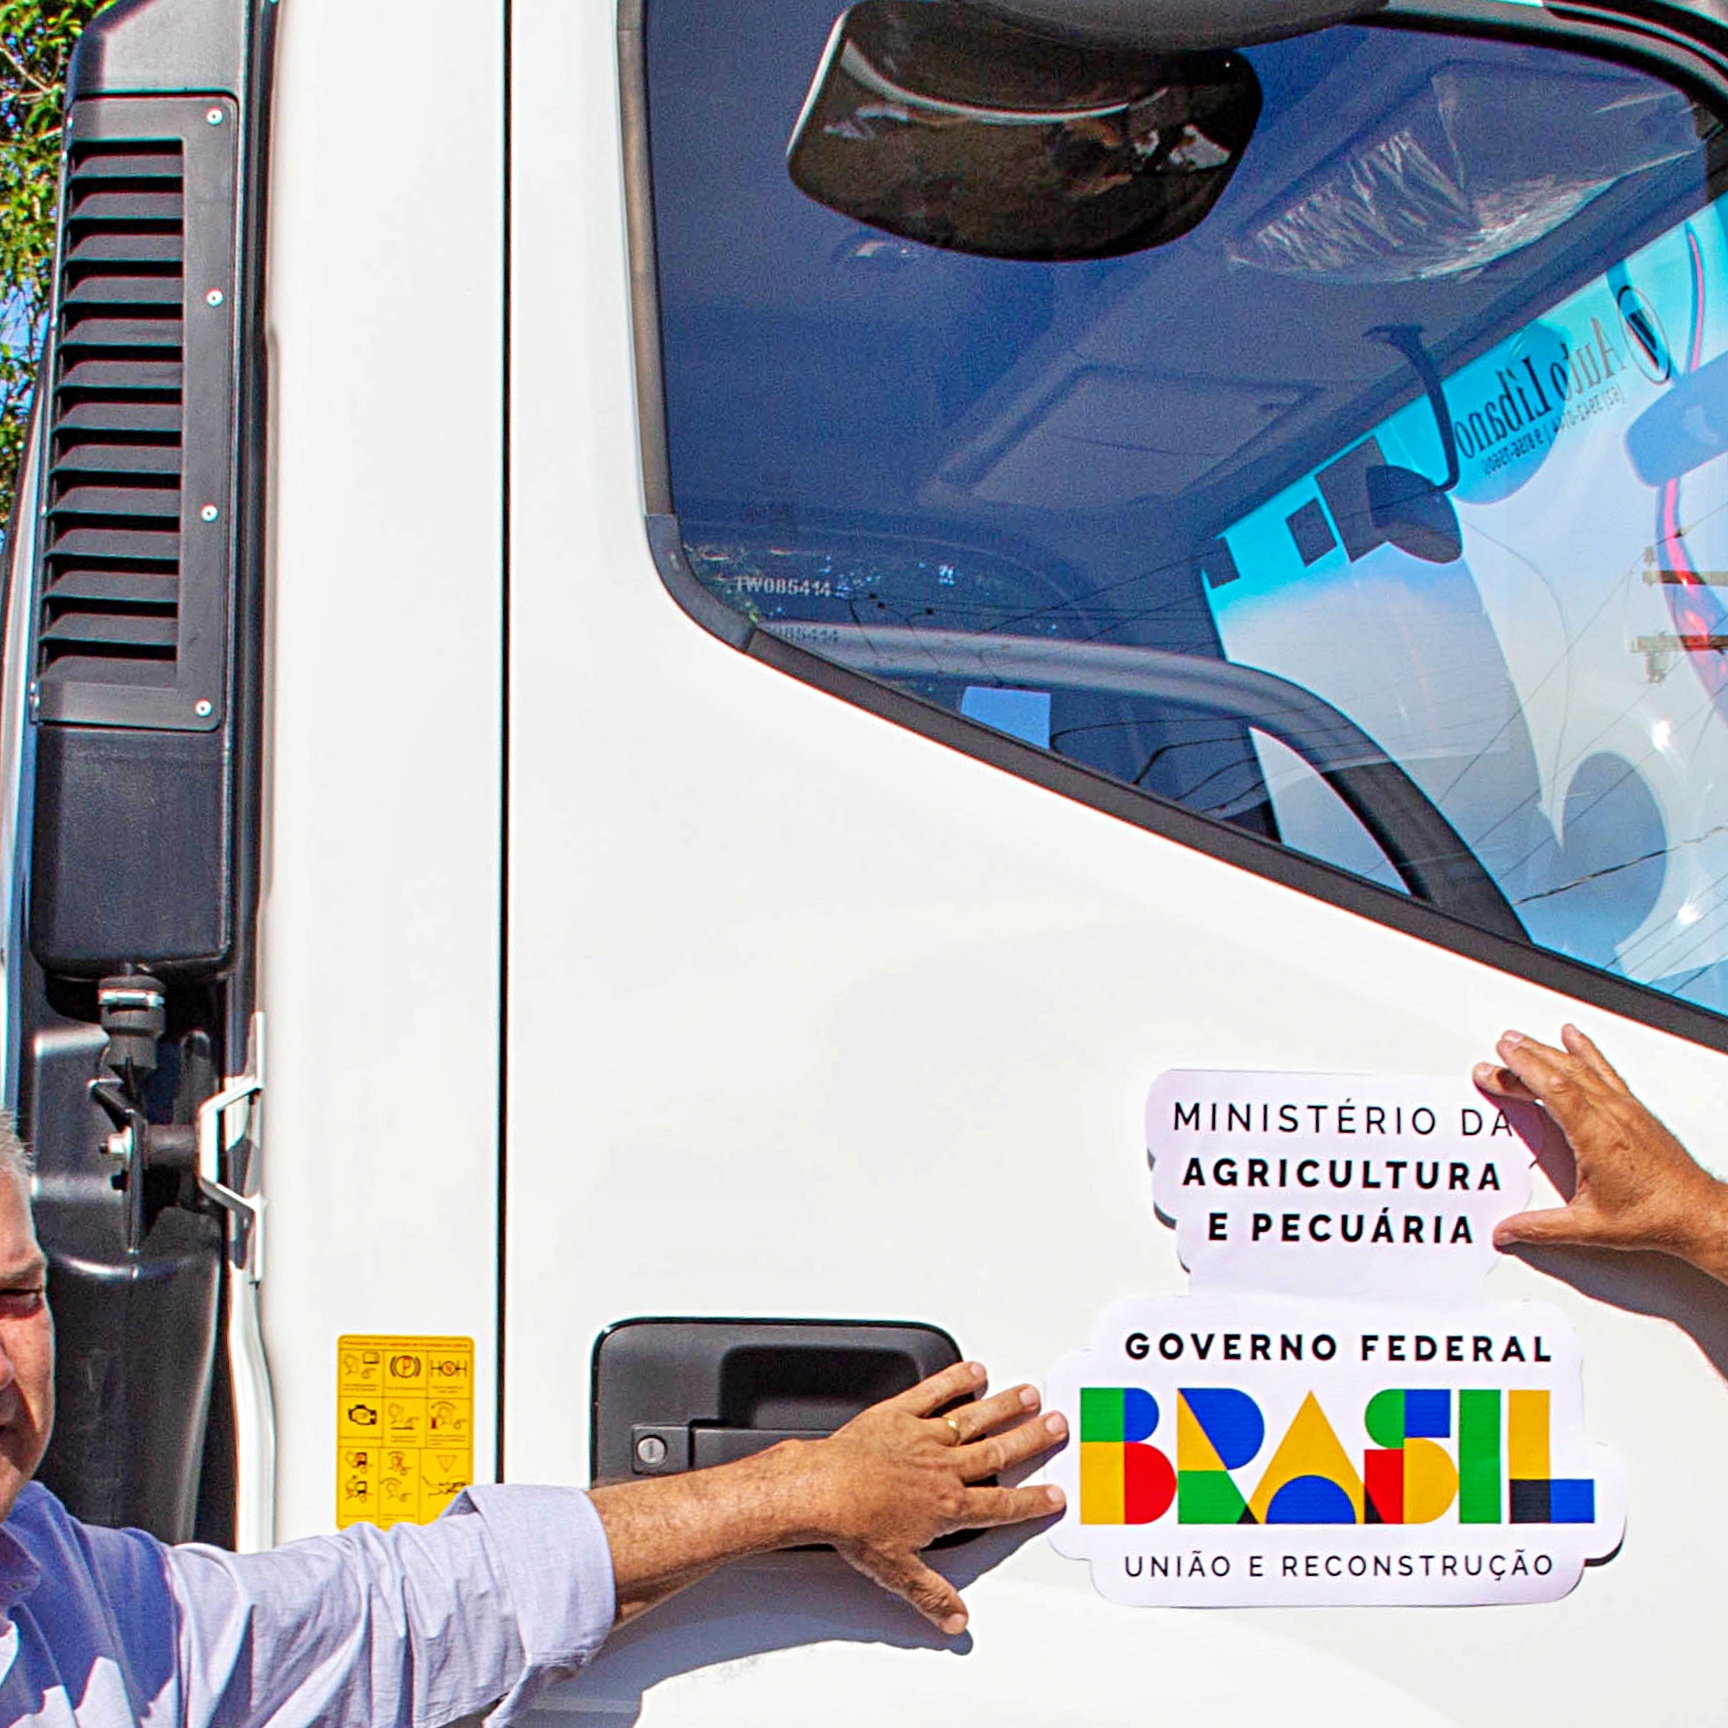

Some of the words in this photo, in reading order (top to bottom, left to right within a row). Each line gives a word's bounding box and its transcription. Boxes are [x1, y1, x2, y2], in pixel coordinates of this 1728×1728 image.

[1174, 1099, 1435, 1135] MINISTÉRIO
[1460, 1104, 1512, 1137] DA
[1183, 1158, 1499, 1190] AGRICULTURA
[1209, 1213, 1227, 1240] E
[1252, 1207, 1472, 1243] PECUÁRIA
[1126, 1333, 1336, 1360] GOVERNO
[1362, 1335, 1550, 1362] FEDERAL
[1080, 1387, 1596, 1525] BRASIL
[1126, 1551, 1229, 1577] UNIÃO
[1250, 1556, 1262, 1576] E
[1283, 1550, 1552, 1580] RECONSTRUÇÃO
